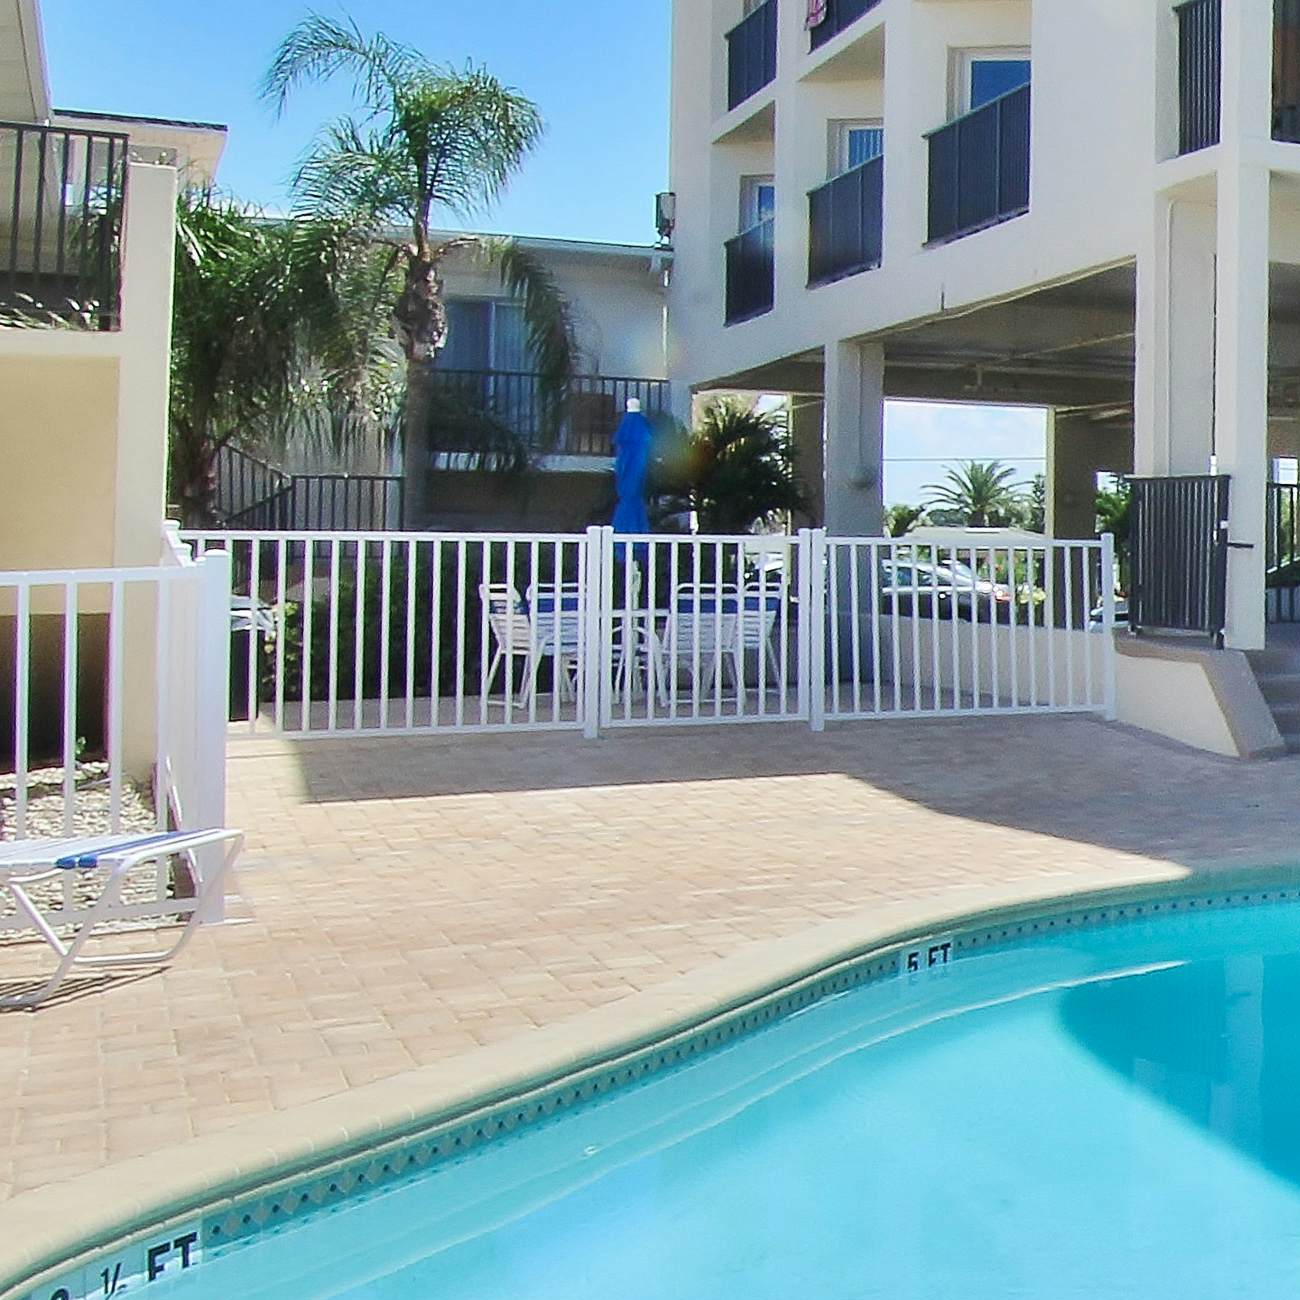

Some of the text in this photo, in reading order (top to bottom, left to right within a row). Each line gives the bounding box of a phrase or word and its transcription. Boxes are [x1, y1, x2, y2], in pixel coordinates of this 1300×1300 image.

[907, 942, 951, 972] 5 FT
[147, 1231, 198, 1282] FT
